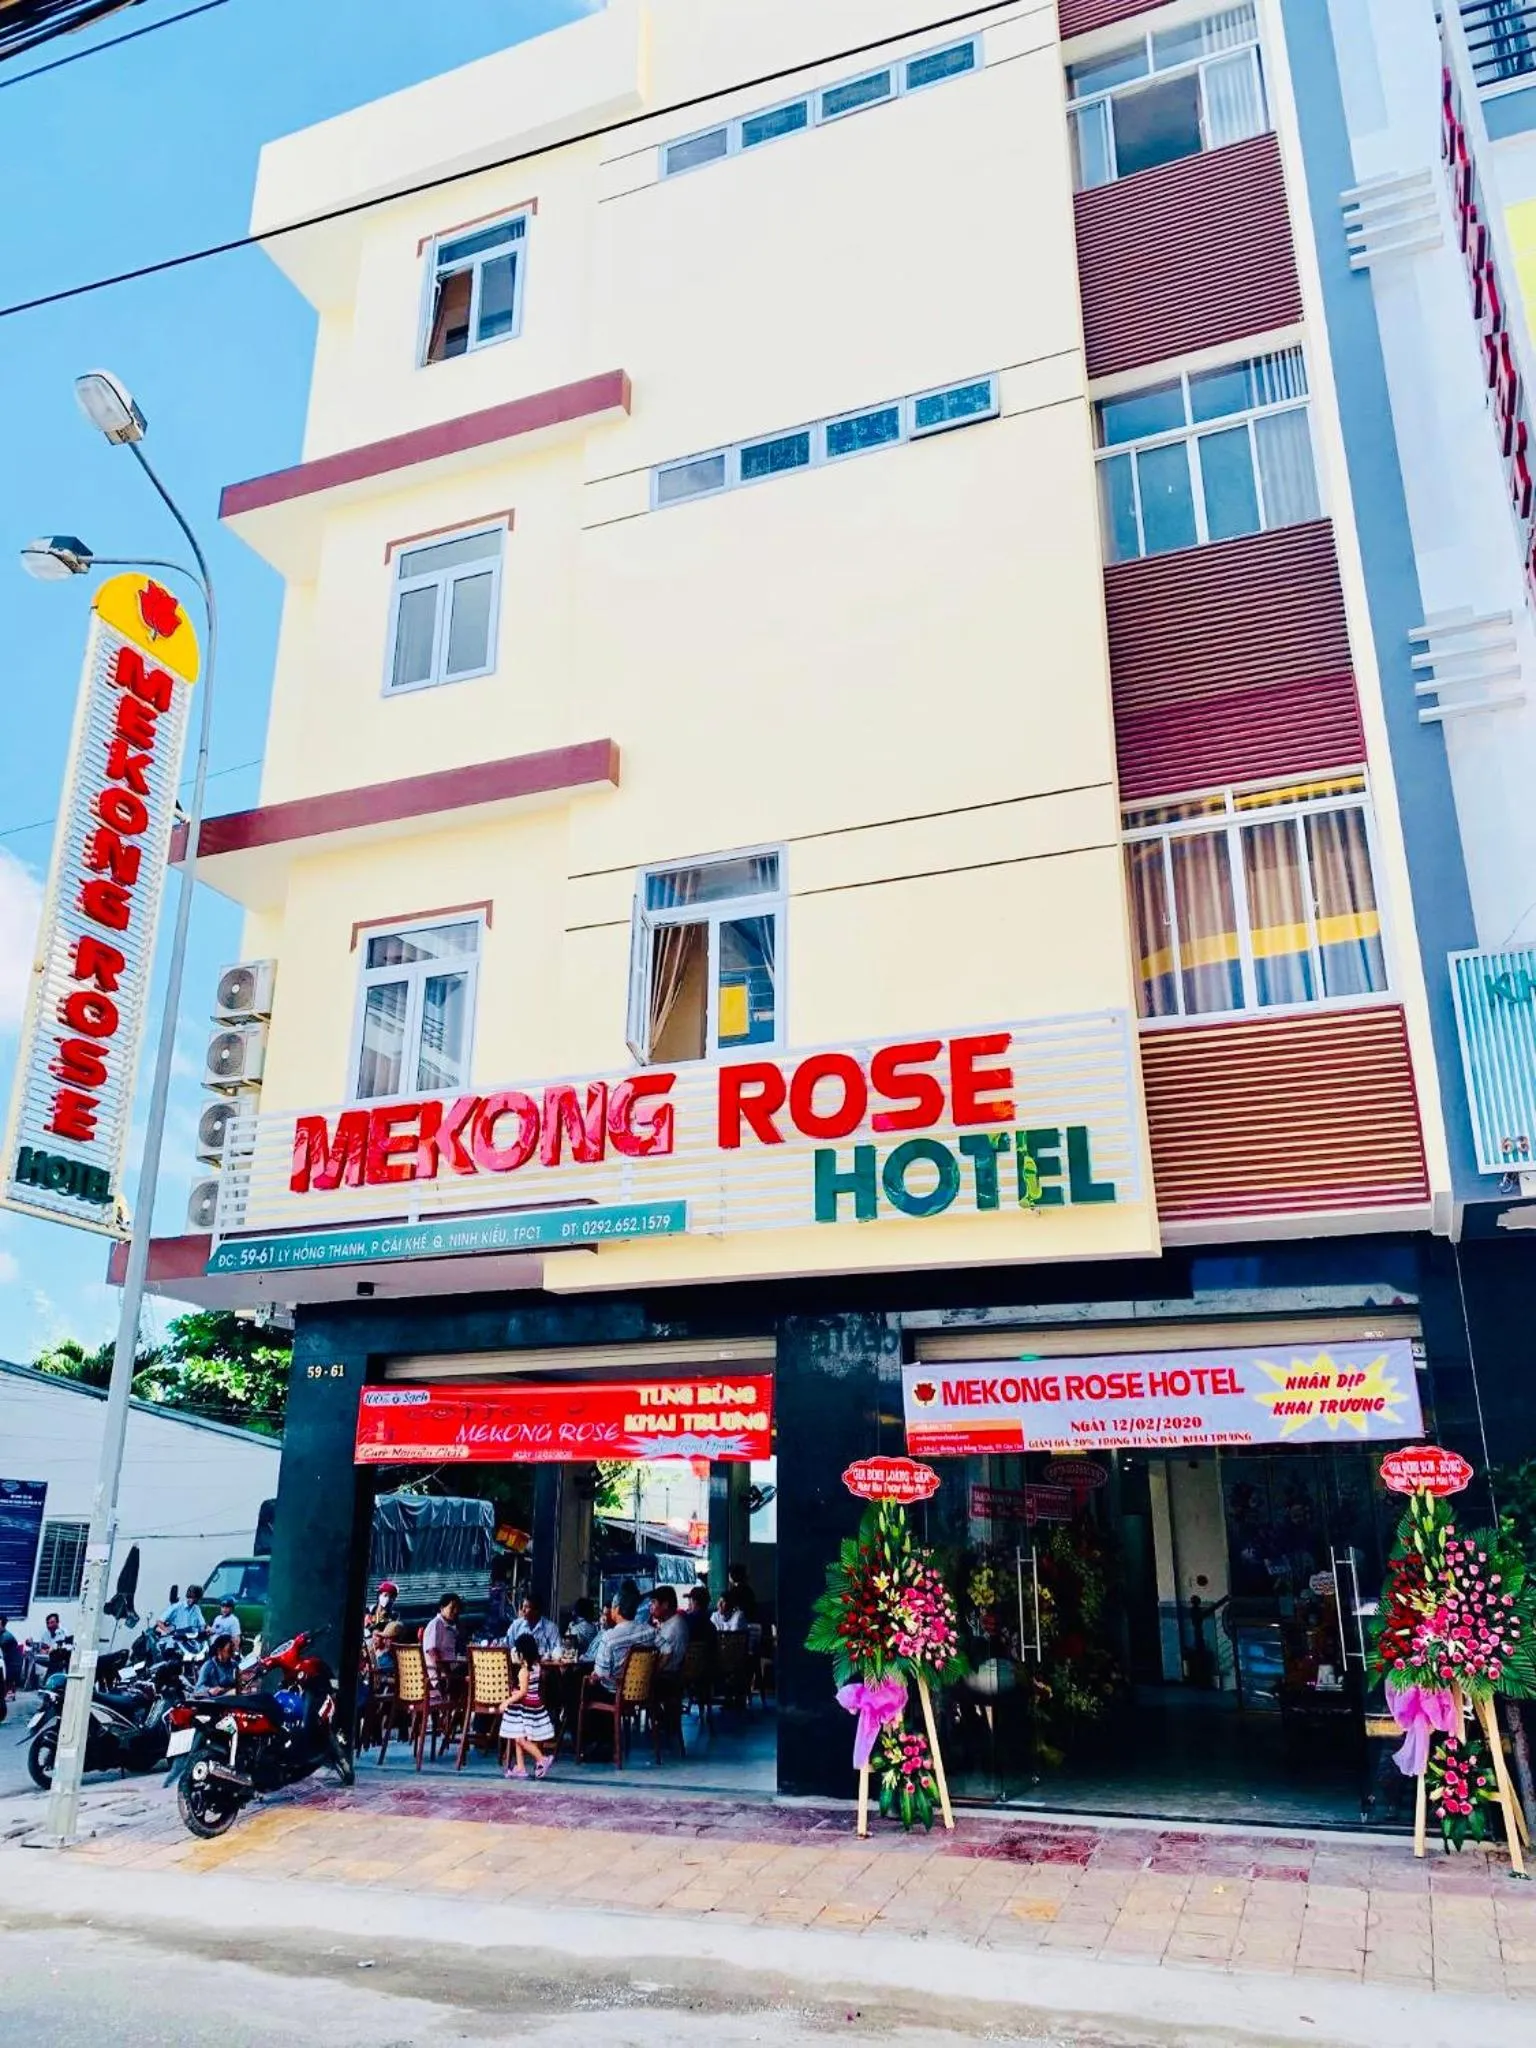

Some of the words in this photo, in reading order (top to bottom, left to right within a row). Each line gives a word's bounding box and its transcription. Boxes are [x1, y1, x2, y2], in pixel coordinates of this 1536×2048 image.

[78, 646, 174, 933] MEKONG
[46, 934, 127, 1142] ROSE
[289, 1072, 677, 1194] MEKONG
[718, 1032, 1017, 1150] ROSE
[15, 1146, 114, 1205] HOTEL
[813, 1125, 1117, 1224] HOTEL
[240, 1246, 275, 1266] 59-61
[449, 1232, 478, 1247] NINH
[582, 1214, 671, 1236] 0292.652.1579
[942, 1376, 1060, 1406] MEKONG
[1066, 1371, 1146, 1401] ROSE
[1149, 1367, 1246, 1398] HOTEL
[1285, 1371, 1331, 1390] NHÂN
[1336, 1372, 1367, 1393] DỊP
[624, 1413, 677, 1433] KHAI
[1112, 1416, 1203, 1433] 12/02/2020
[1272, 1400, 1313, 1415] KHAI
[1319, 1396, 1385, 1414] TRƯƠNG
[455, 1423, 552, 1443] MEKONG
[559, 1421, 621, 1442] ROSE
